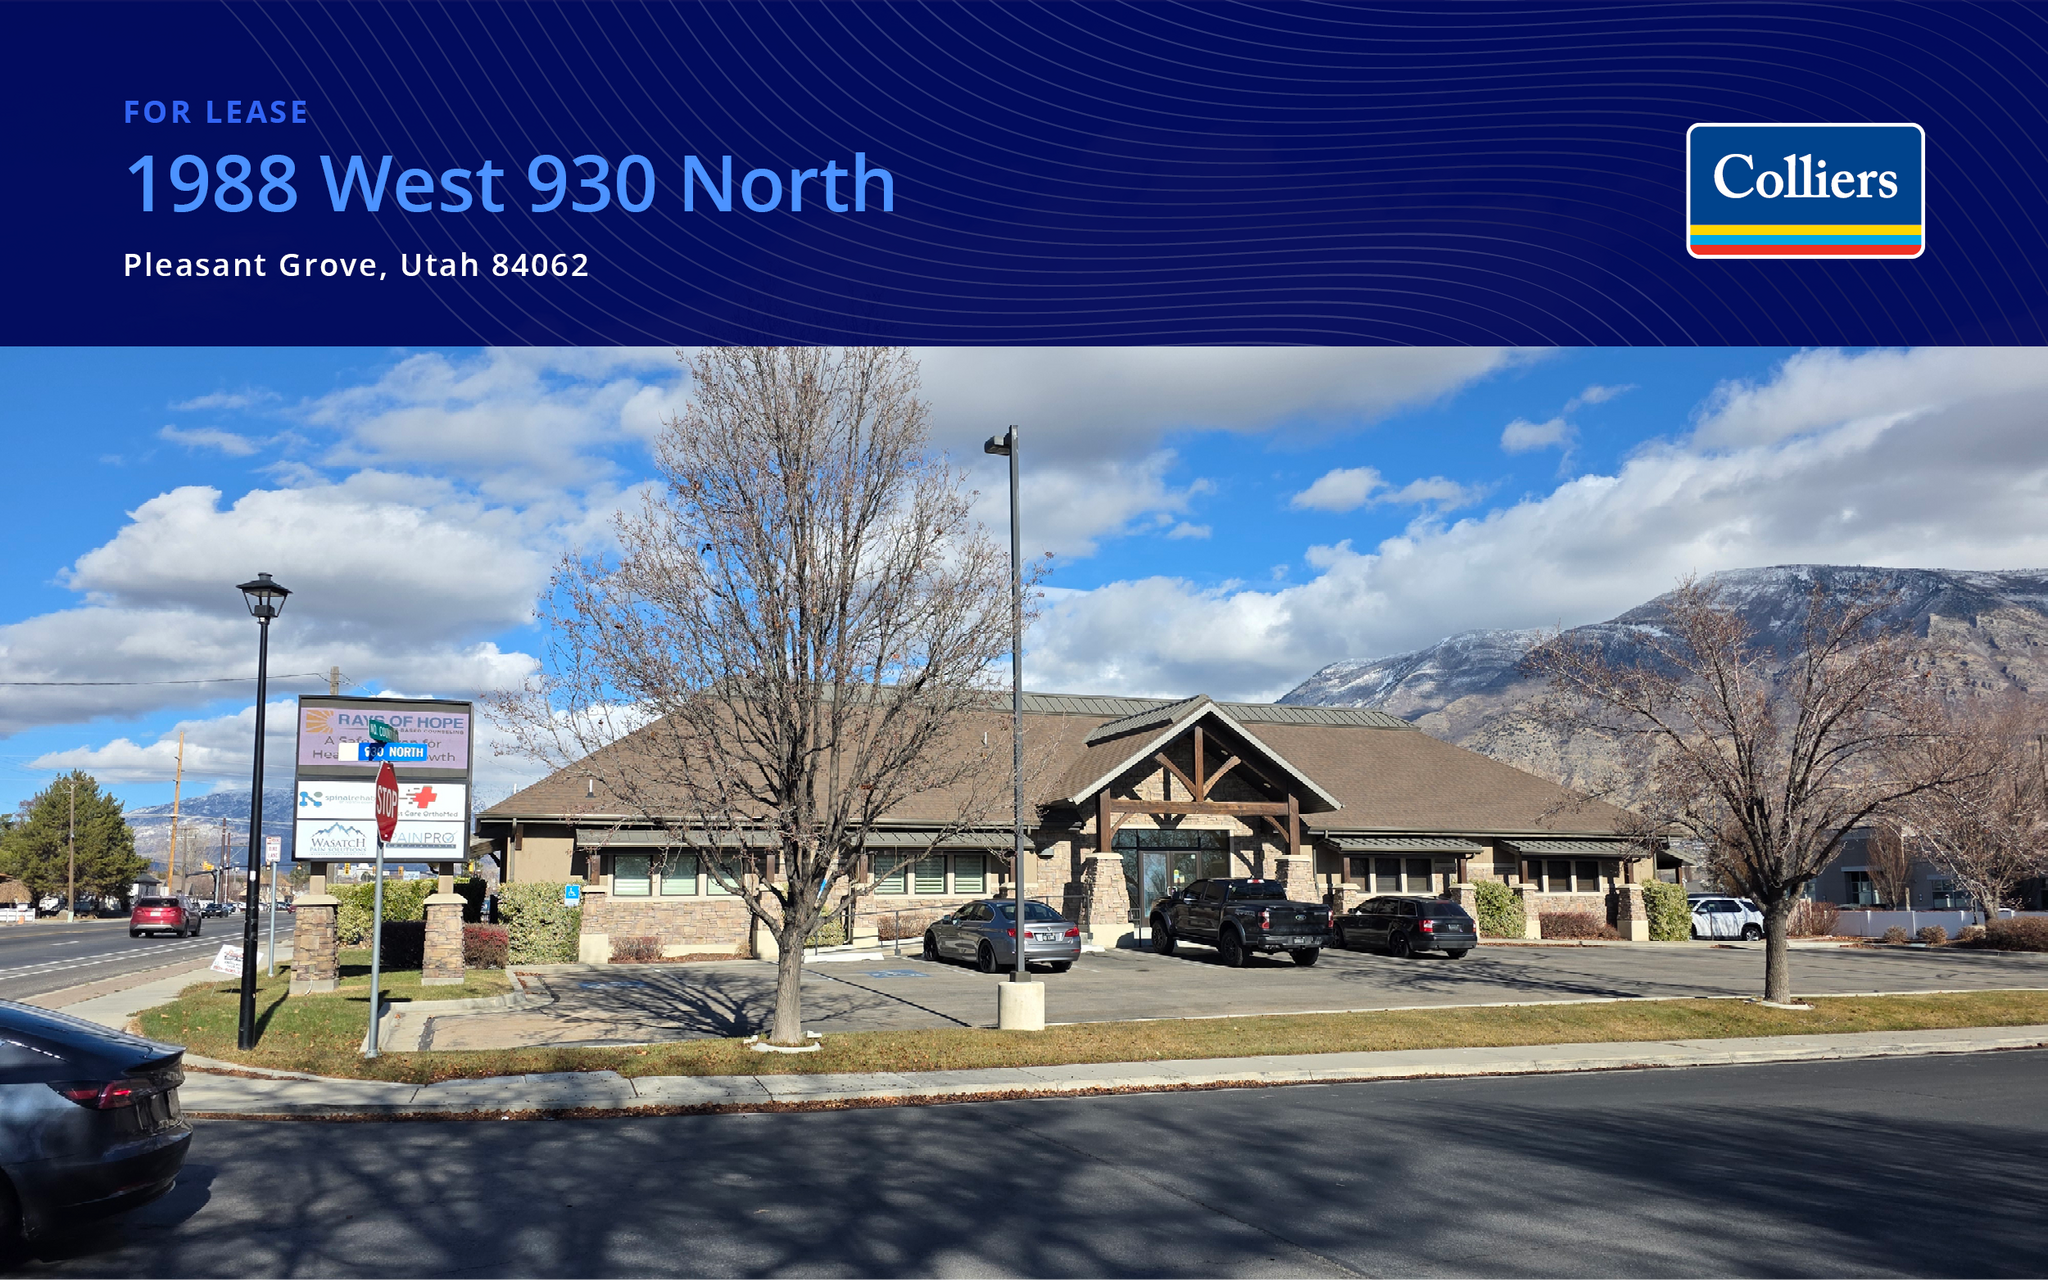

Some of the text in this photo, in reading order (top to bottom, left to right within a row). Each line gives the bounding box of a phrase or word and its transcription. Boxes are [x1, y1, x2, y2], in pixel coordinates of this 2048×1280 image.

[389, 715, 413, 728] OF
[417, 717, 464, 729] HOPE
[324, 736, 335, 746] A
[389, 746, 424, 758] NORTH
[376, 784, 398, 819] STOP
[423, 810, 458, 818] OrthoMed
[311, 838, 366, 848] WASATCH
